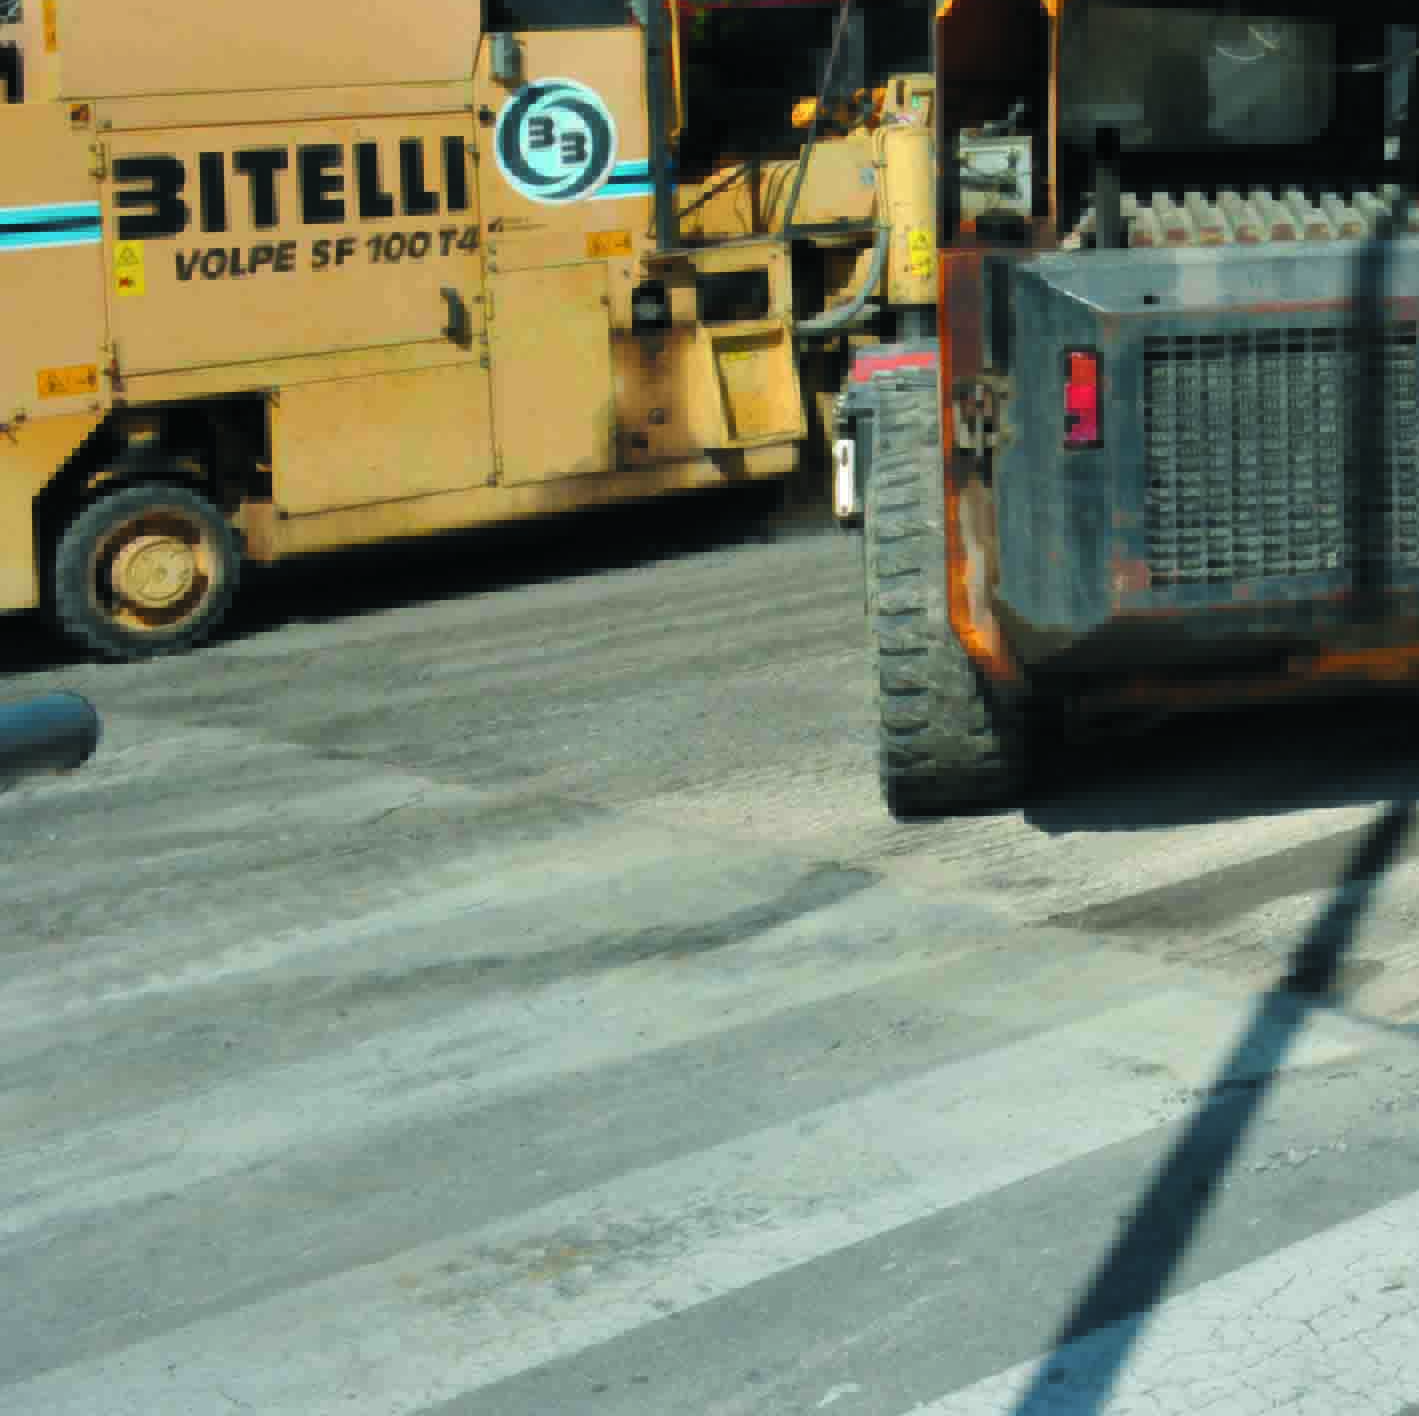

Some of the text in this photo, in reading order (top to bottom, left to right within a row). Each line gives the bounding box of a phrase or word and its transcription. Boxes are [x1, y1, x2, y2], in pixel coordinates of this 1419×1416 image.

[111, 135, 470, 240] BITELLI
[174, 225, 481, 282] VOLPE SF 100 T4
